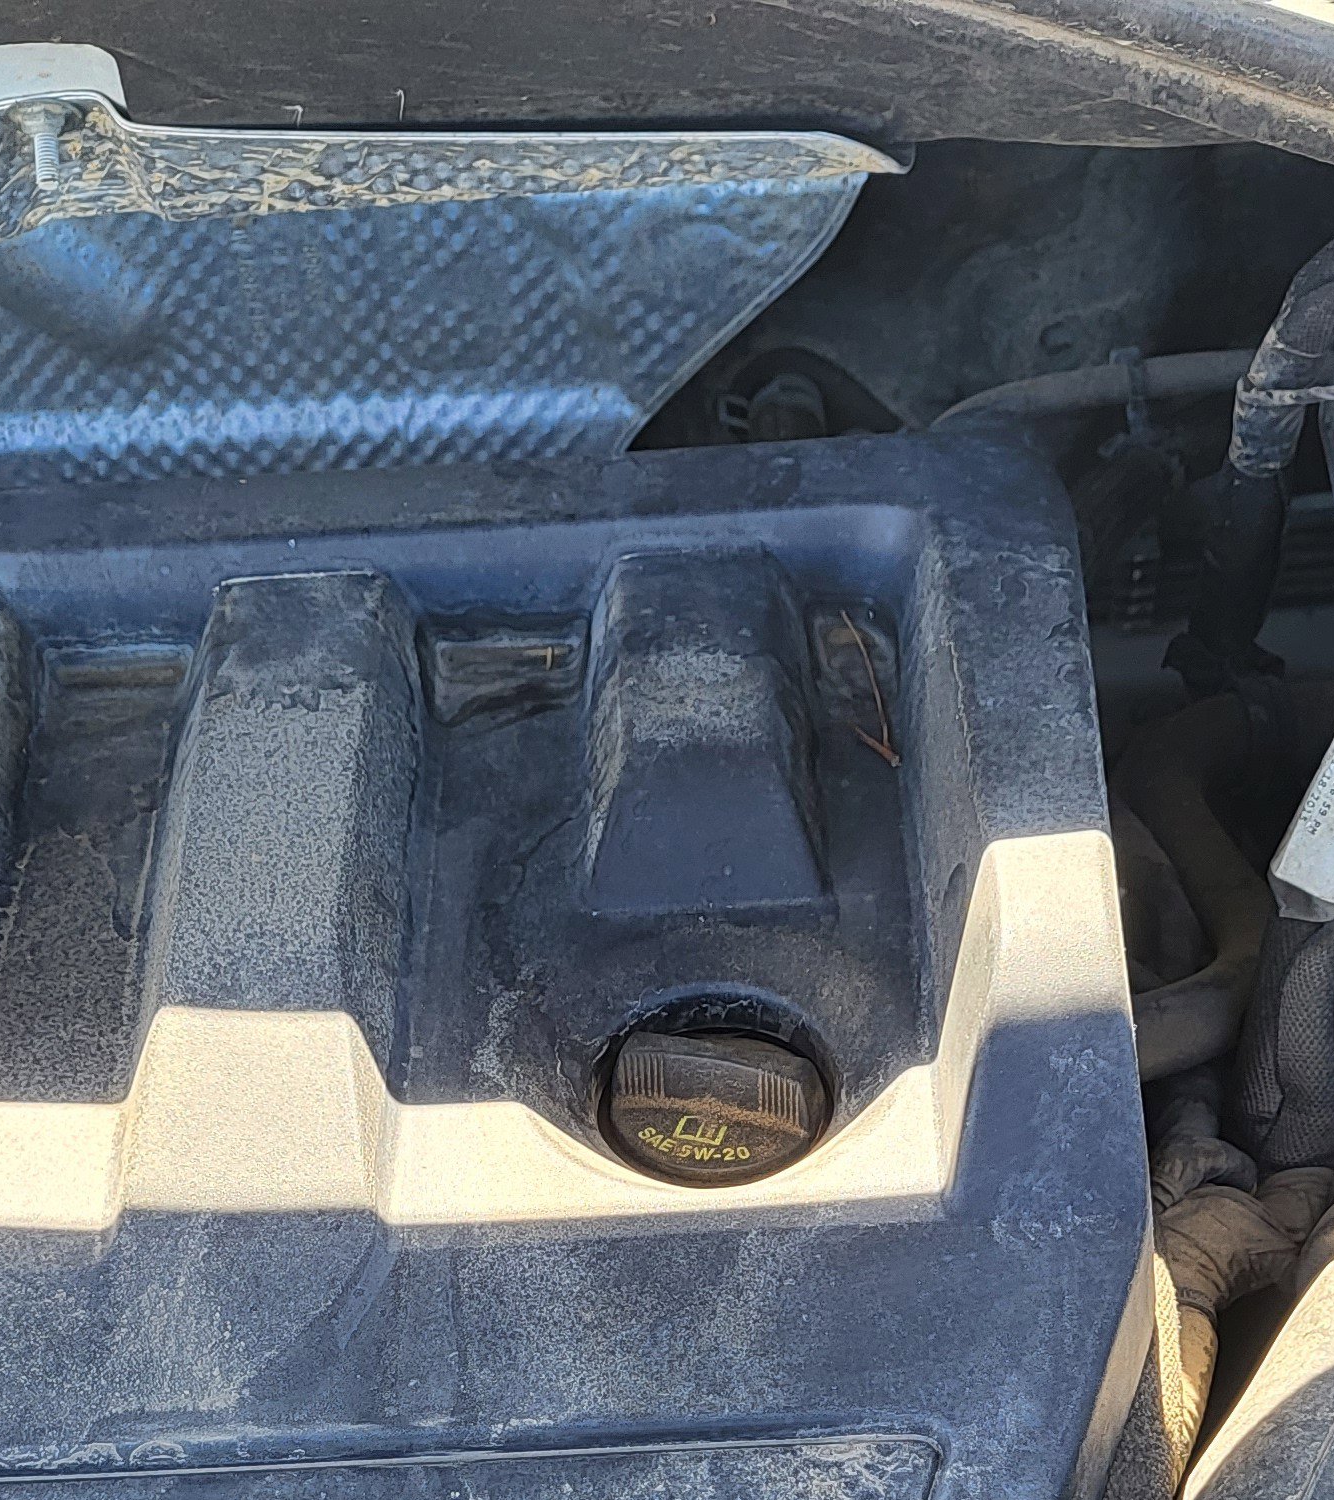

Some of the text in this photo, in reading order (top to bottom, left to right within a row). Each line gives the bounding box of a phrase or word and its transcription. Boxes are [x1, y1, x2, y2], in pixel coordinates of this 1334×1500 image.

[1307, 820, 1323, 836] PM
[638, 1126, 752, 1163] SAE 5W-20
